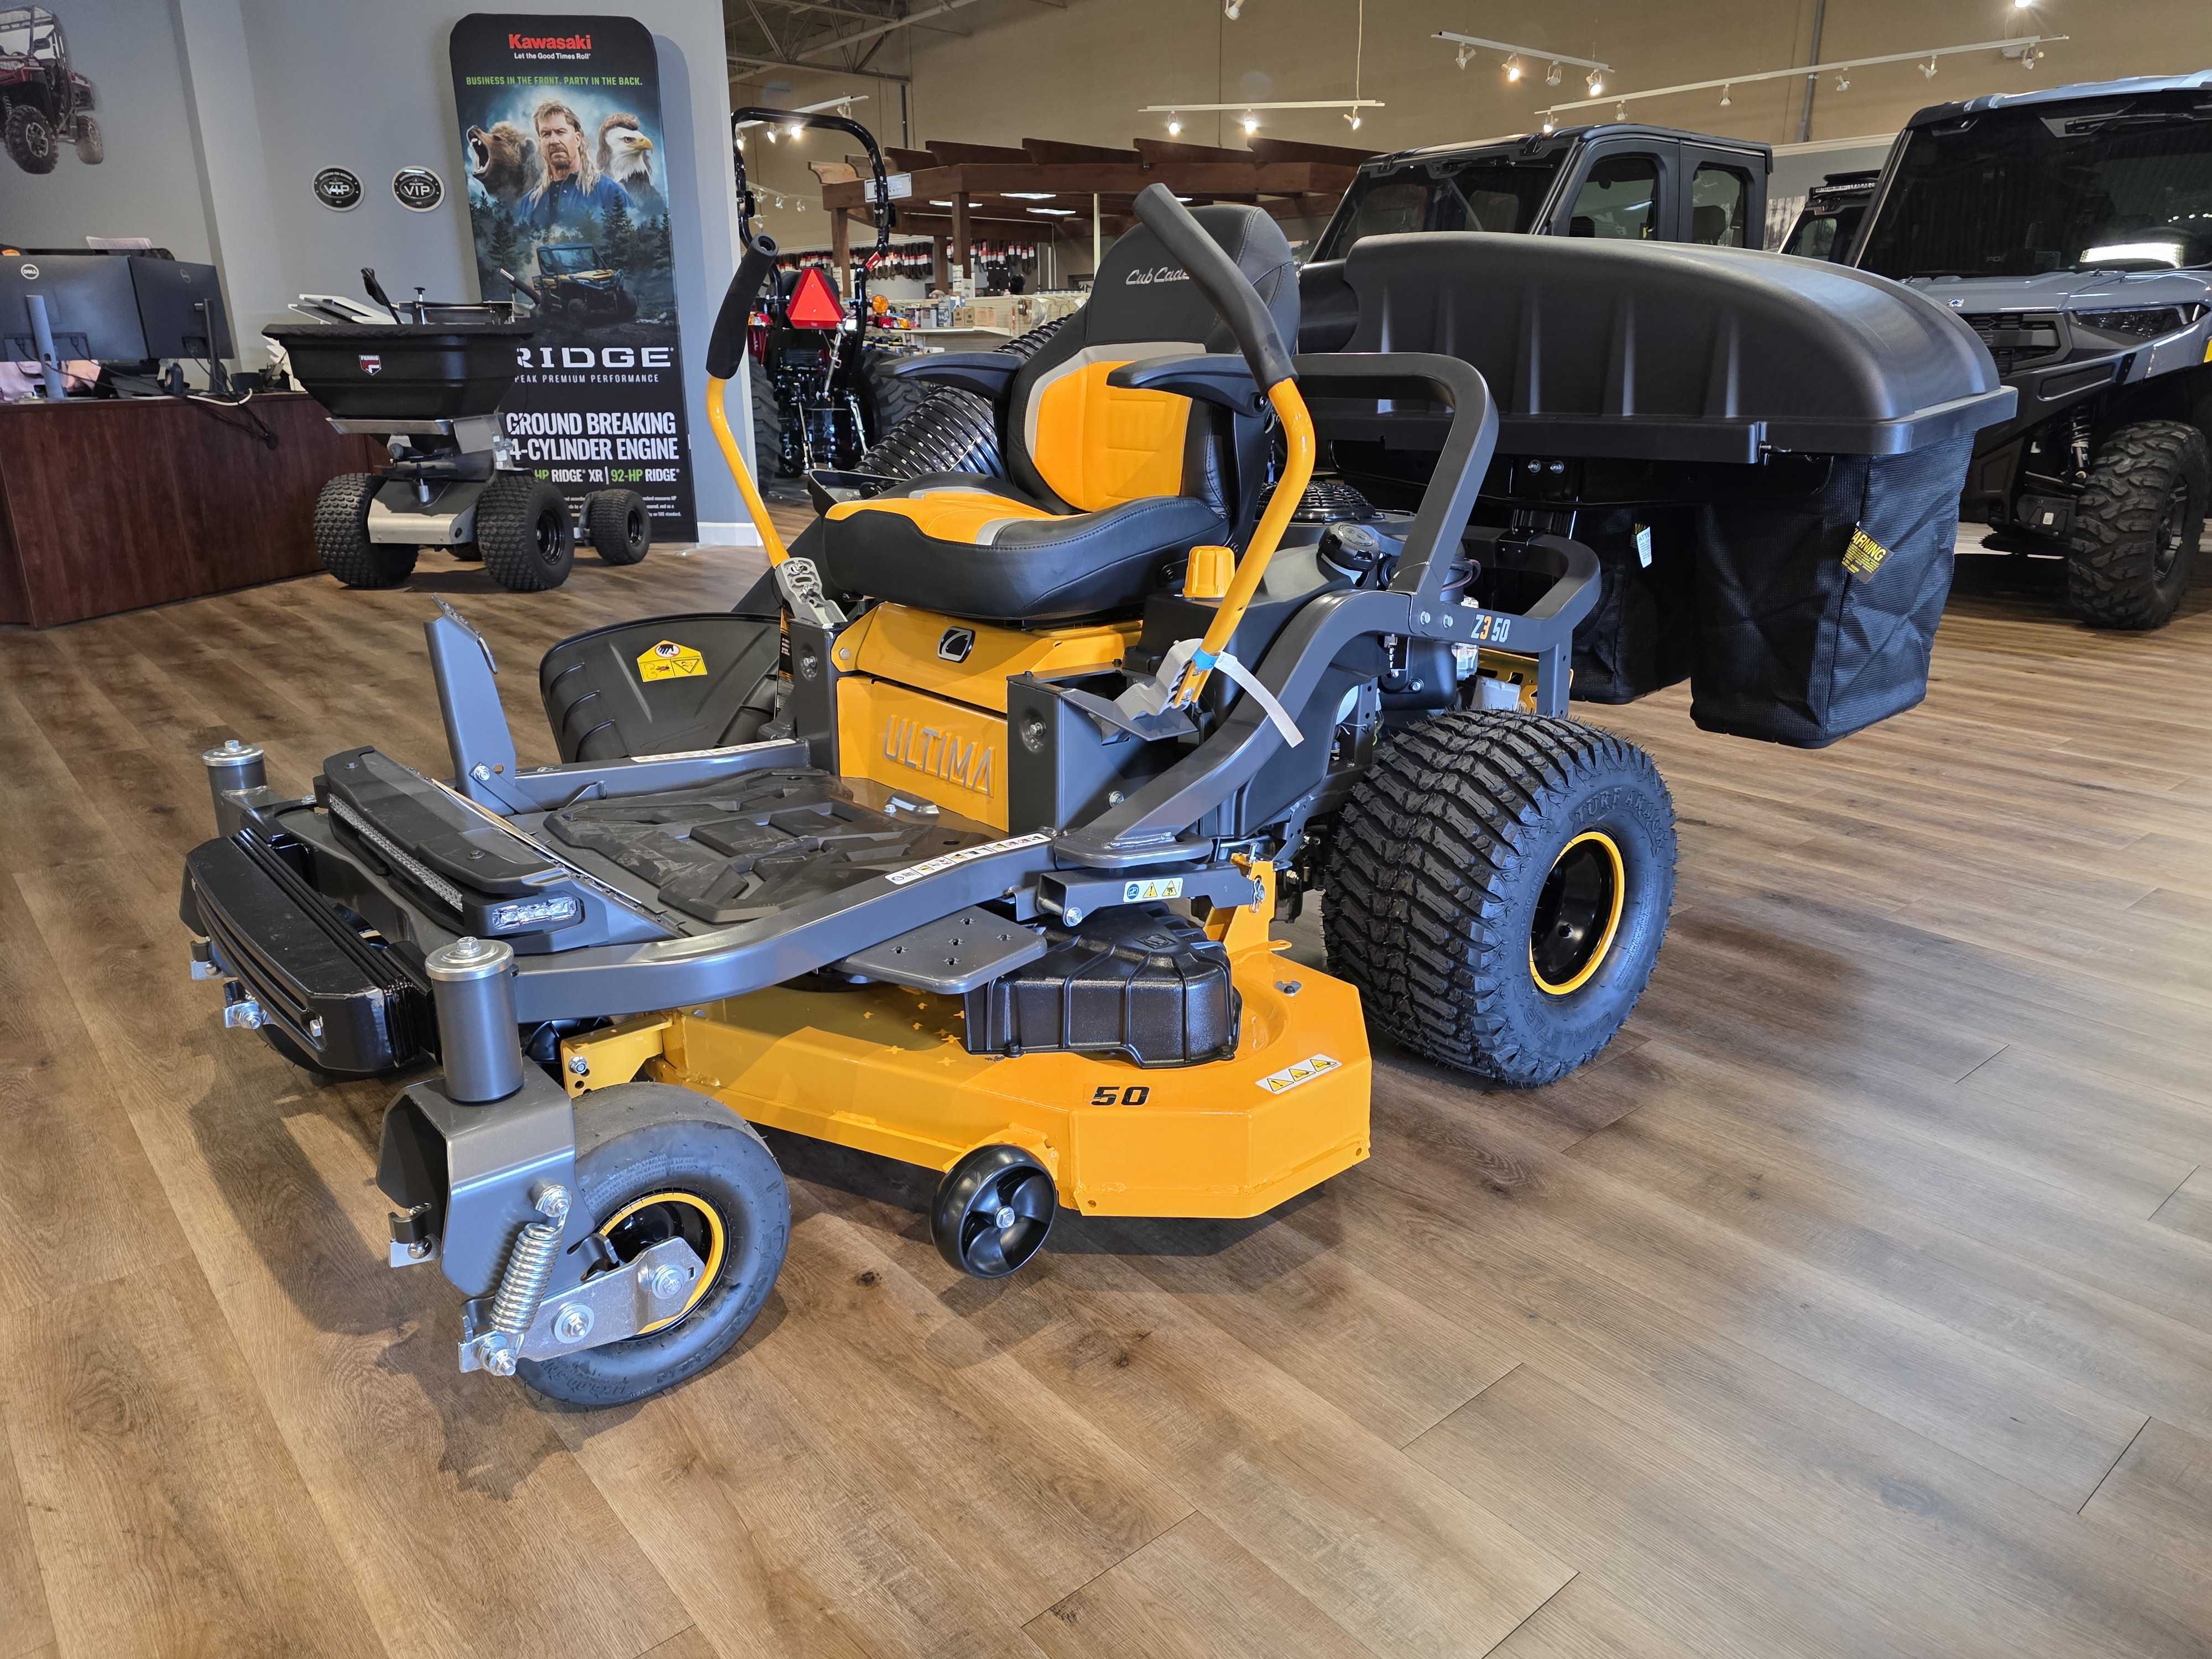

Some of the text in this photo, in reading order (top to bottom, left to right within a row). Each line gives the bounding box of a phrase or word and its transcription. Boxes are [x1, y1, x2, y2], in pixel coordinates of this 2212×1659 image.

[509, 34, 591, 49] Kawasaki
[466, 76, 643, 85] BUSINESS IN THE FRONT. PARTY IN THE BACK.
[404, 186, 430, 196] VIP
[1126, 267, 1190, 285] Cub Cade
[542, 374, 586, 383] PREMIUM
[591, 374, 659, 383] PERFORMANCE
[506, 412, 676, 435] GROUND BREAKING
[509, 437, 679, 460] 4-CYLINDER ENGINE
[588, 469, 603, 482] XR
[611, 469, 643, 482] 92-HP
[884, 715, 995, 797] ULTIMA
[1575, 787, 1622, 824] TURF
[1091, 1086, 1150, 1106] 50
